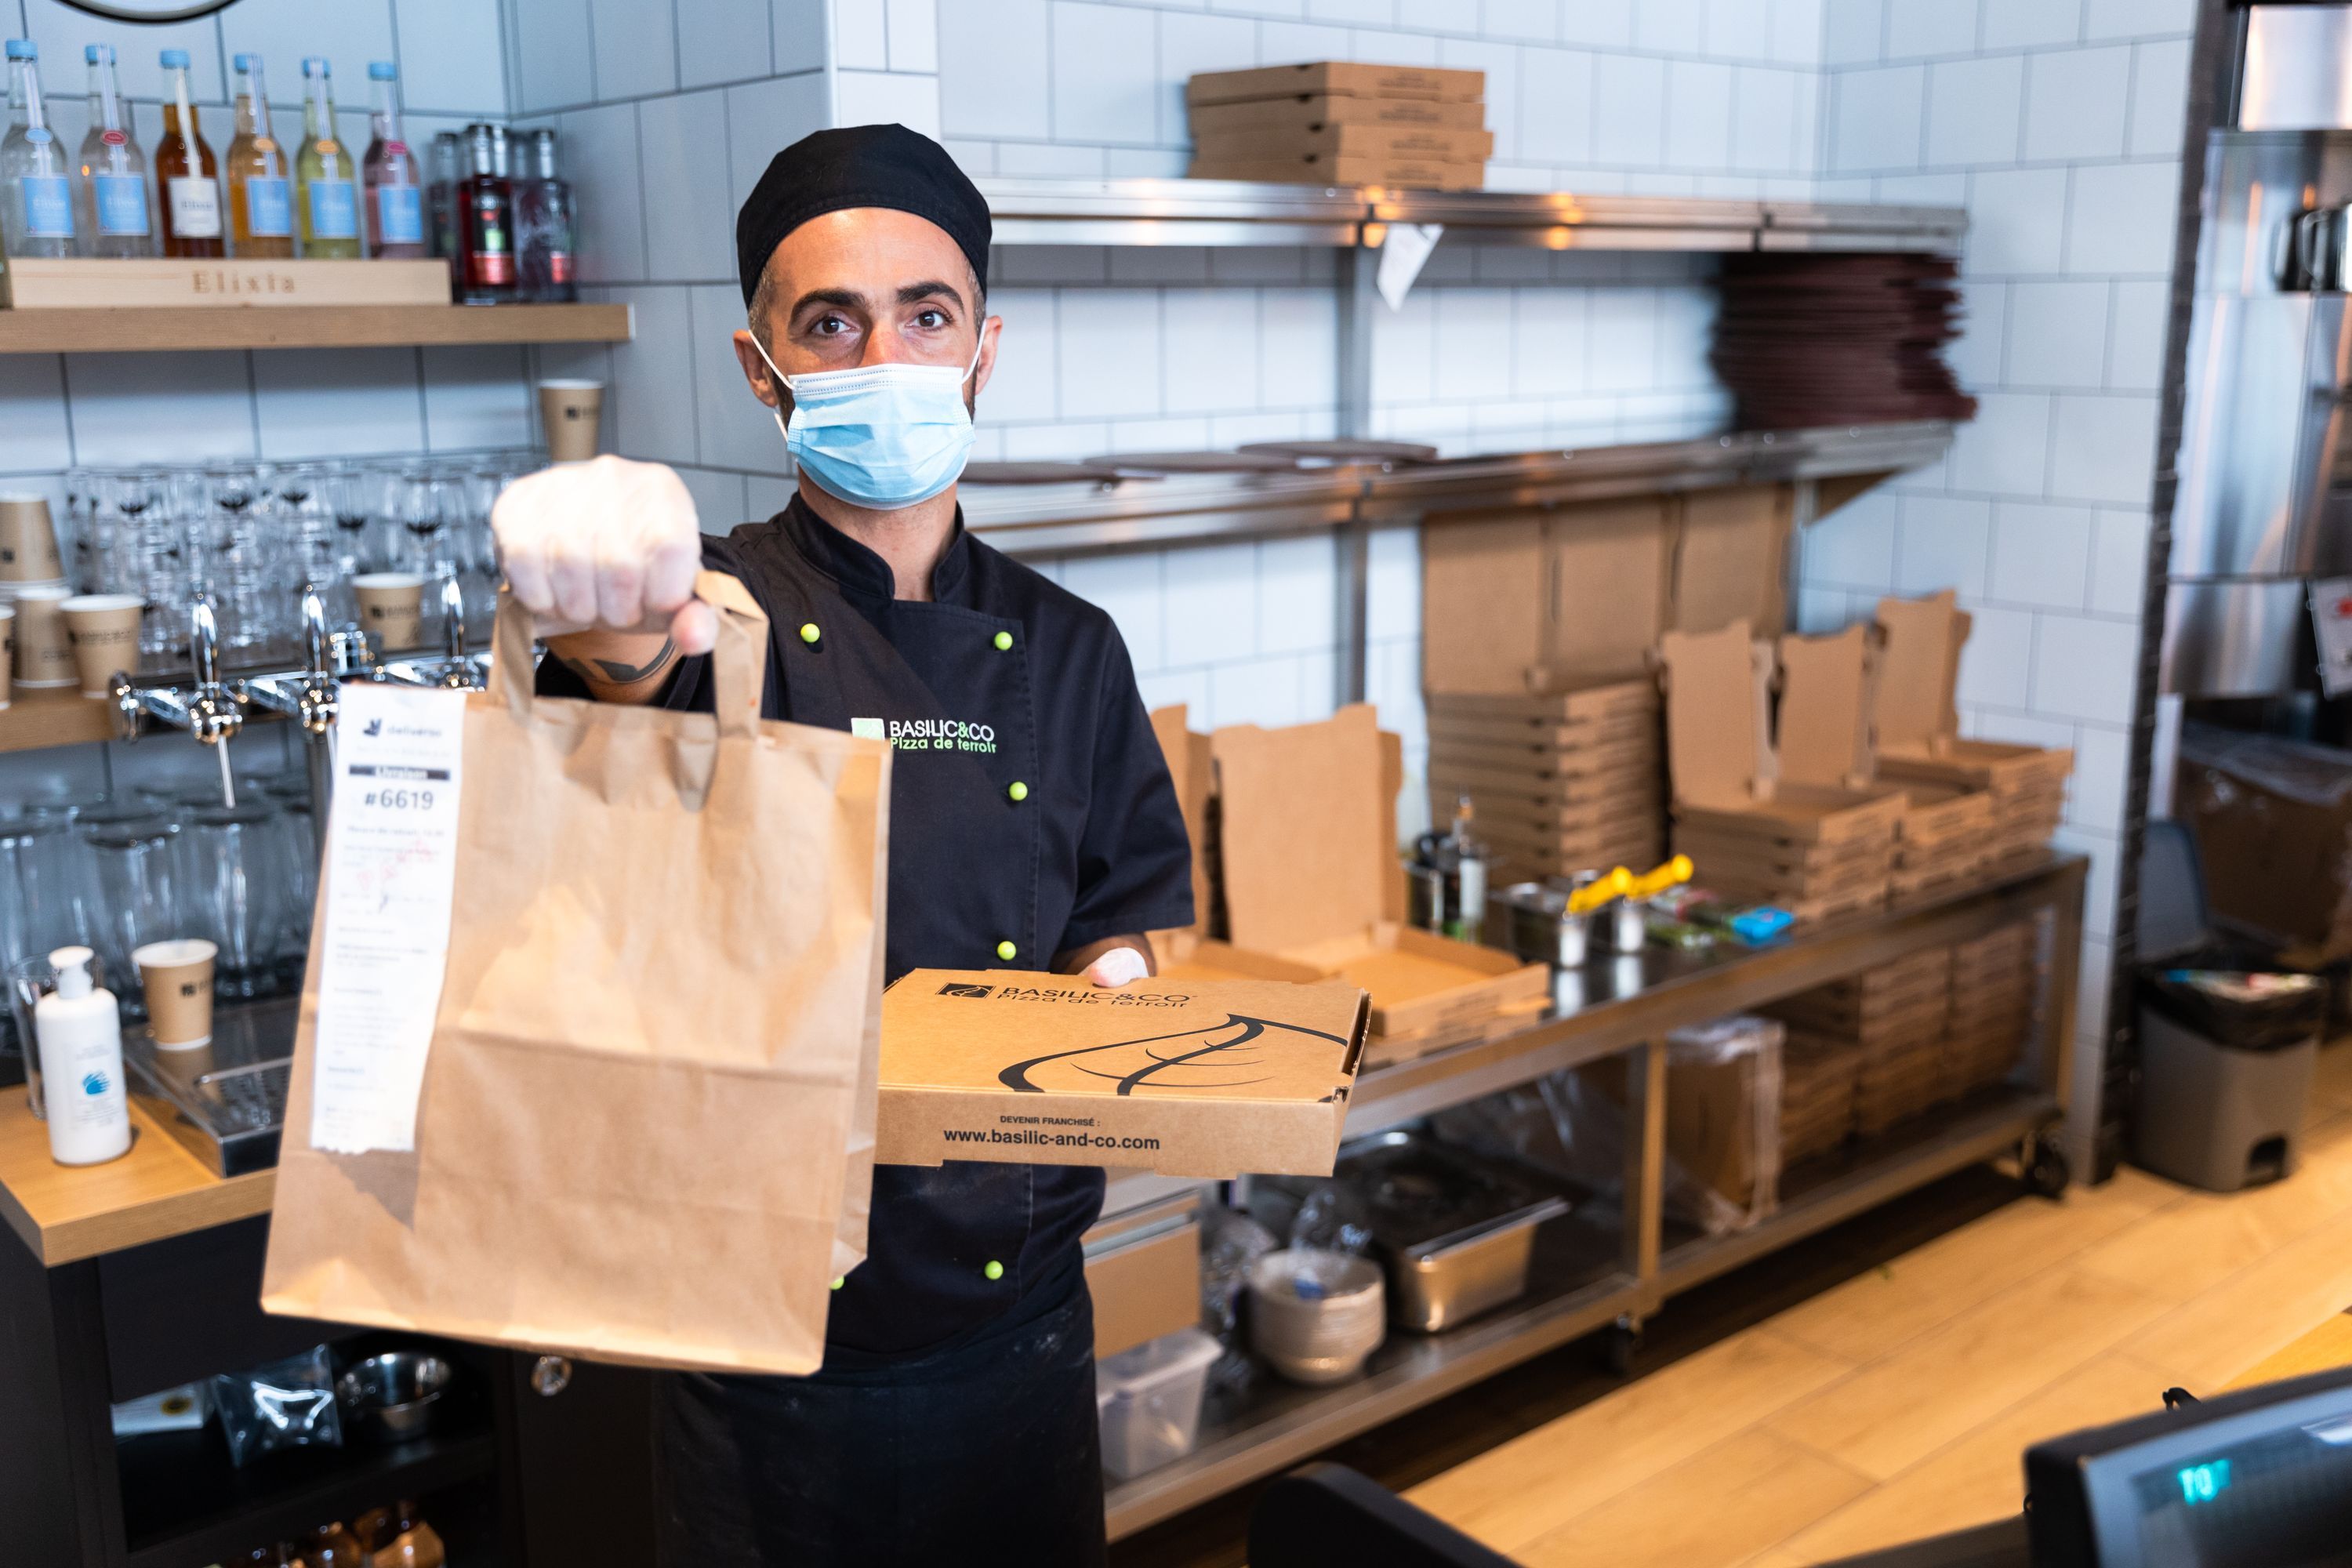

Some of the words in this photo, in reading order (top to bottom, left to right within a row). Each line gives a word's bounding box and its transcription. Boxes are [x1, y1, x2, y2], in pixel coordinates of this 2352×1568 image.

[889, 719, 995, 742] BASILIC&CO
[890, 737, 928, 750] Pizza
[934, 736, 953, 750] de
[957, 738, 997, 753] terroir
[364, 788, 434, 811] #6619
[996, 993, 1058, 1003] Pizza
[1111, 999, 1189, 1008] terroir
[1001, 987, 1191, 1002] BASILIC&CO
[1000, 1116, 1040, 1125] DEVENIR
[1042, 1116, 1095, 1127] FRANCHISÉ
[943, 1128, 1161, 1150] www.basilic-and-co.com
